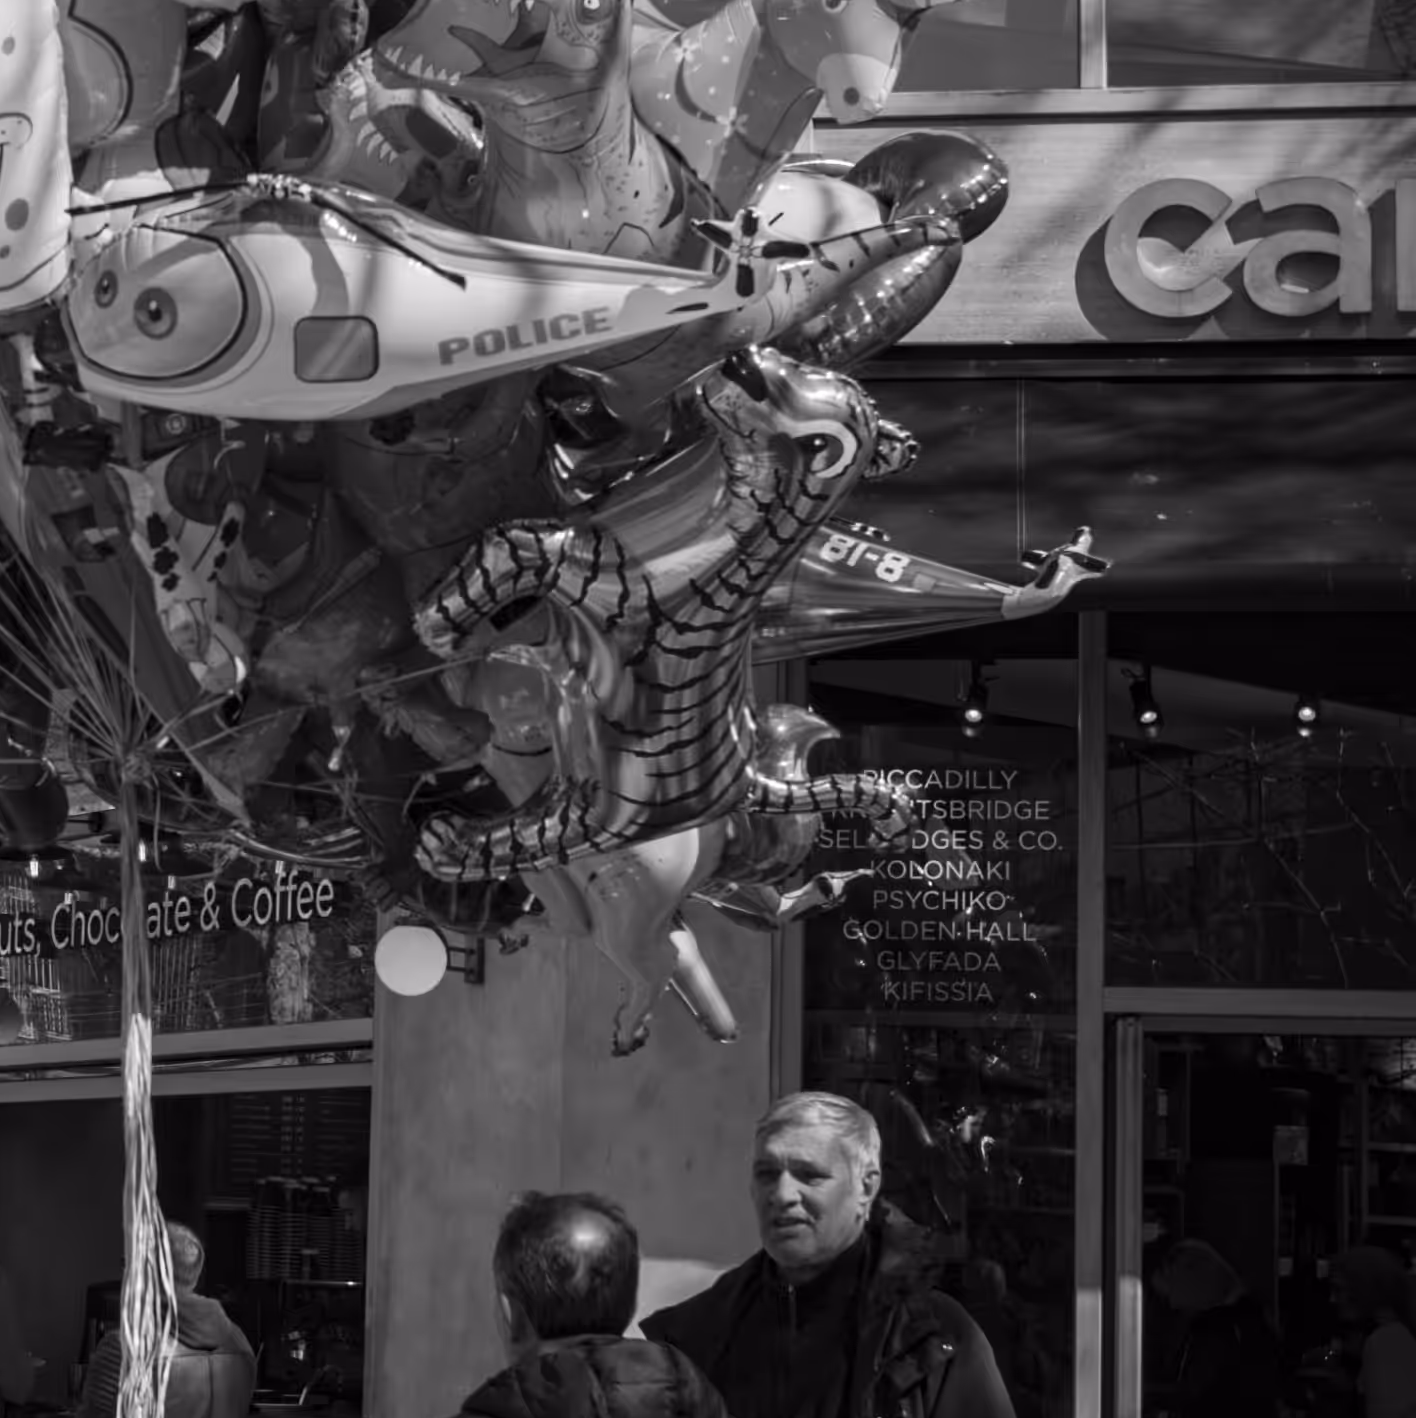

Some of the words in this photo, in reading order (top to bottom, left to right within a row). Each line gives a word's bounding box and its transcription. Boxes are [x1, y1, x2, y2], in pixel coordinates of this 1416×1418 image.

[438, 306, 612, 365] POLICE
[818, 829, 983, 850] SELDGES
[992, 830, 1010, 850] &
[1018, 830, 1064, 851] CO.
[871, 860, 1010, 880] KOLONAKI
[51, 891, 191, 950] Chocate
[200, 882, 220, 931] &
[231, 871, 335, 927] Coffee
[873, 890, 1007, 911] PSYCHIKO
[842, 920, 956, 942] GOLDEN
[966, 921, 1037, 943] HALL
[877, 950, 1002, 972] GLYFADA
[883, 981, 995, 1003] KIFISSIA
